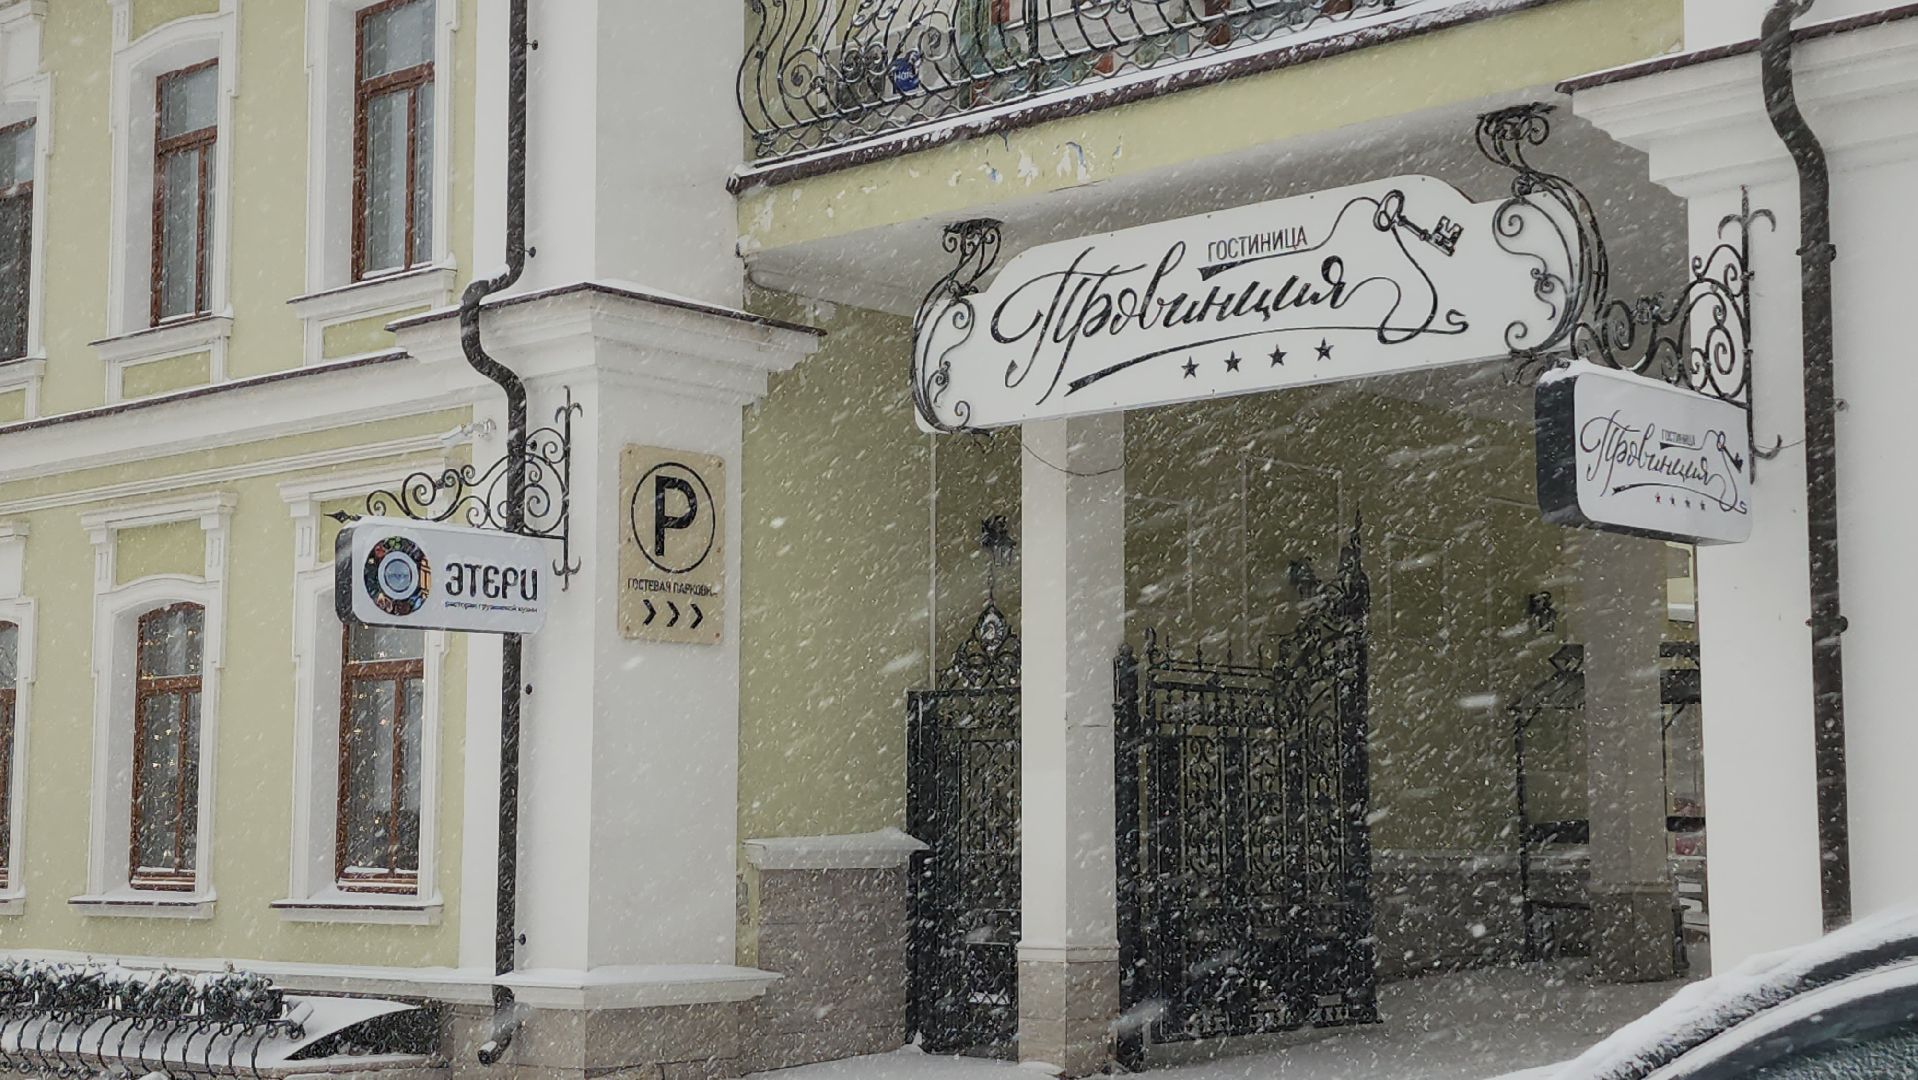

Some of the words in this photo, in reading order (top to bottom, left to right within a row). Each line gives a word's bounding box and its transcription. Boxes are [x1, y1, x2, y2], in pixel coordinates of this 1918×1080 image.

[1207, 225, 1309, 263] ГОСТИНИЦА
[989, 241, 1355, 405] Провинция
[1580, 409, 1714, 497] Провинция
[655, 475, 698, 557] P
[627, 578, 671, 593] ГОСТЕВАЯ
[673, 582, 718, 598] ПАРКОВК
